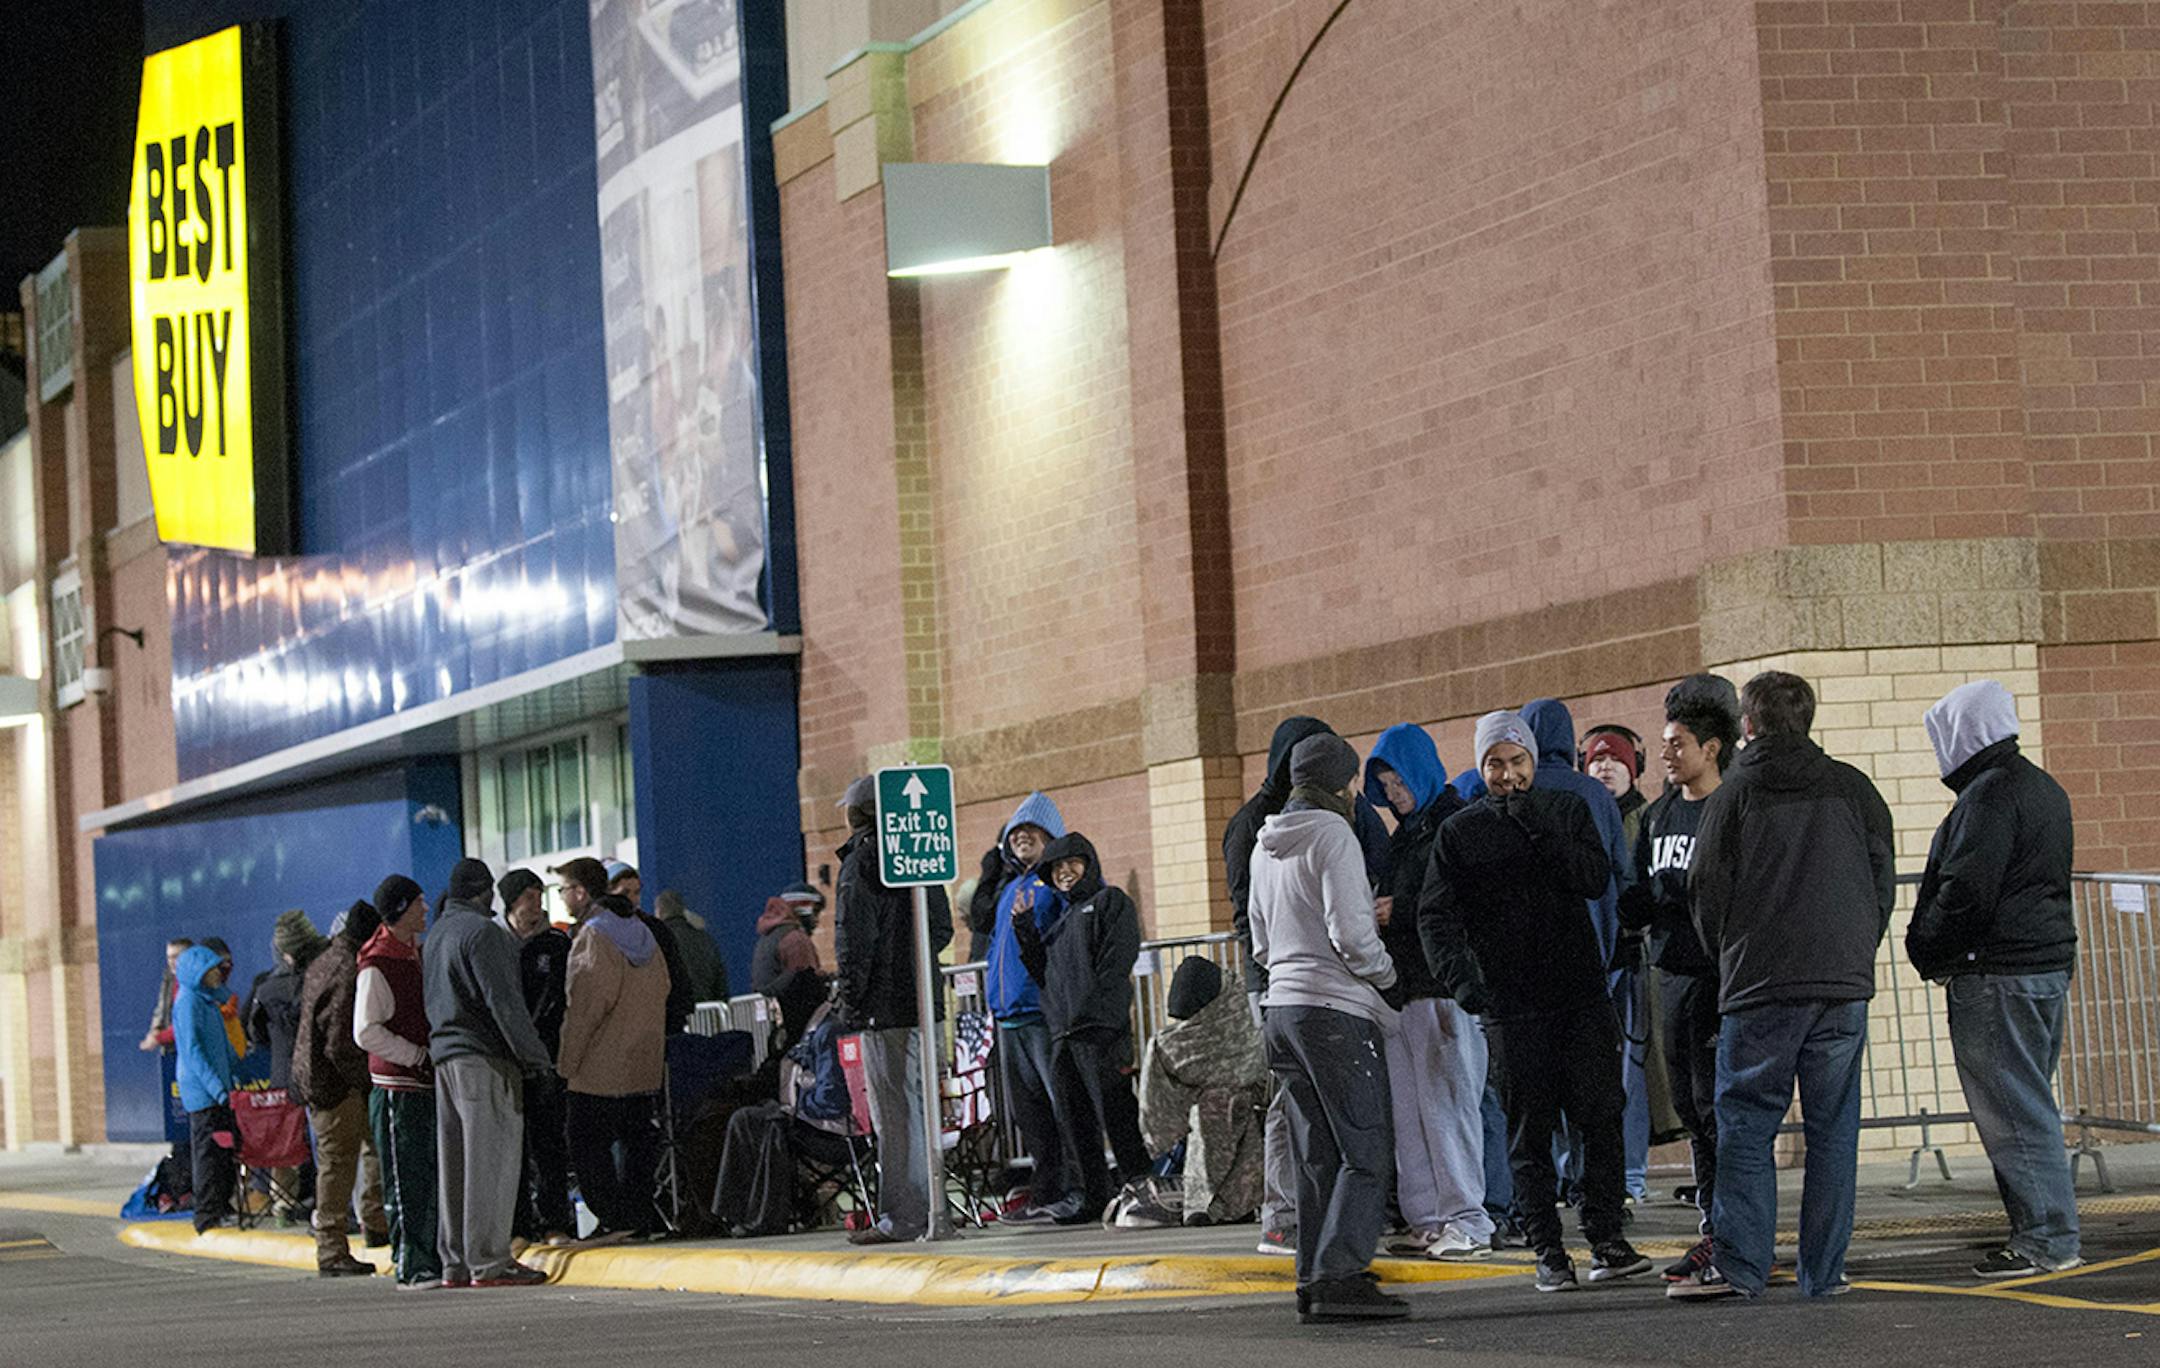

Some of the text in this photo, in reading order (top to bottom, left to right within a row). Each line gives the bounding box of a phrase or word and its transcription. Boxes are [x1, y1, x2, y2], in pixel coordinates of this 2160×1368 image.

[146, 121, 235, 283] BEST
[155, 310, 232, 458] BUY
[885, 810, 947, 832] Exit To
[885, 832, 951, 854] W. 77th
[893, 854, 946, 875] Street
